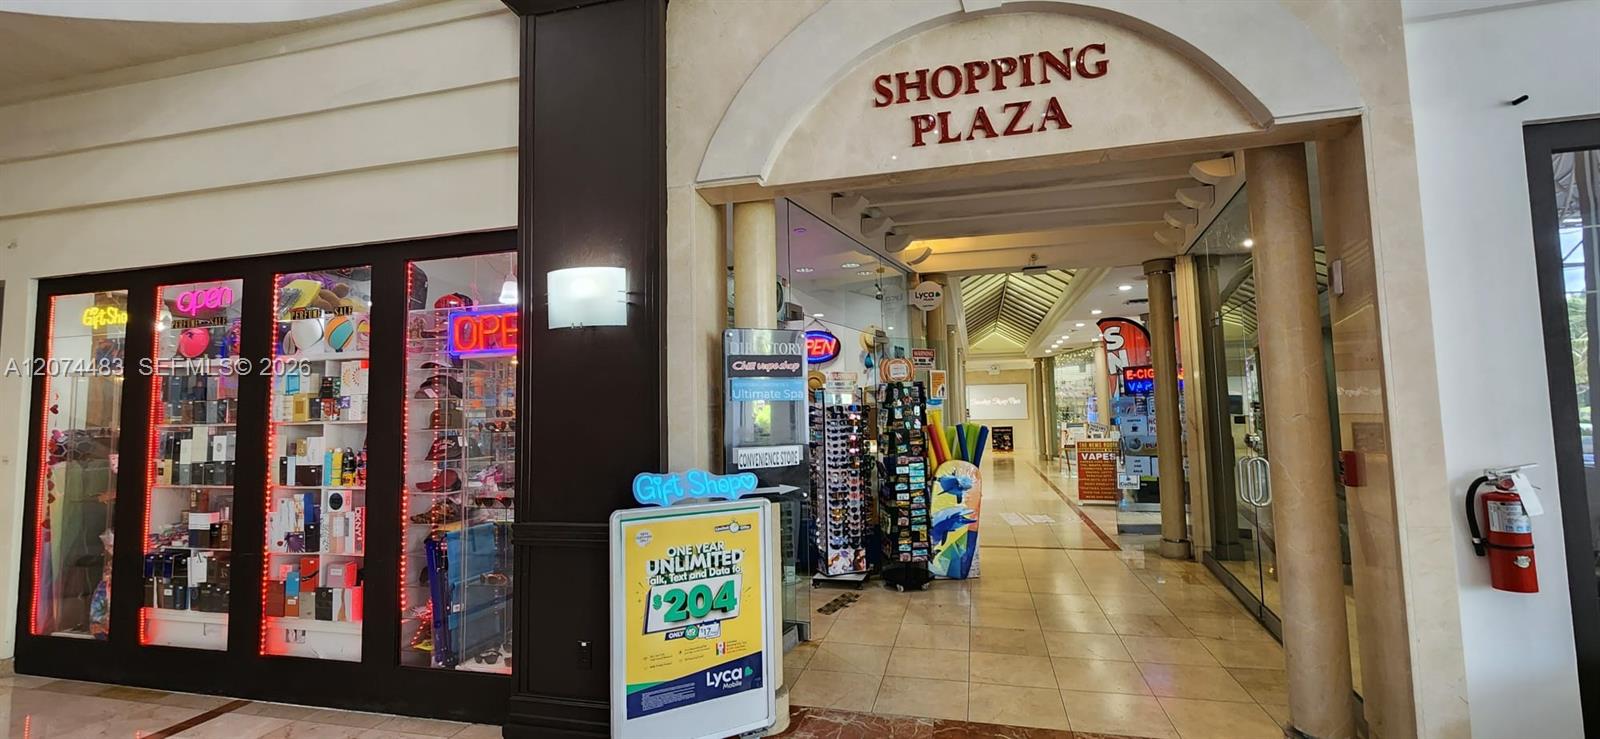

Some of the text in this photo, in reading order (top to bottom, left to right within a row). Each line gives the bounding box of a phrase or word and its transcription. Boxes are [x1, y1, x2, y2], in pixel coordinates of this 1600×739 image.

[872, 43, 1109, 108] SHOPPING
[911, 96, 1072, 147] PLAZA
[177, 287, 233, 316] open
[914, 291, 934, 300] Lyca
[82, 306, 128, 330] Gift Sho
[454, 312, 518, 351] OPE
[804, 338, 837, 355] PEN
[1125, 368, 1155, 380] E-CIG
[732, 388, 804, 400] Ultimate Spa
[1128, 382, 1153, 392] VAP
[740, 450, 798, 467] CONVENIENCE STORE
[636, 470, 740, 507] Gift Shop
[354, 507, 362, 537] DKNY
[667, 540, 725, 558] ONE YEAR
[646, 549, 743, 576] UNLIMITED
[669, 570, 688, 582] Text
[689, 567, 707, 579] and
[708, 564, 730, 576] Data
[652, 580, 738, 623] $204
[706, 666, 743, 688] Lyca
[722, 682, 743, 690] Mobile
